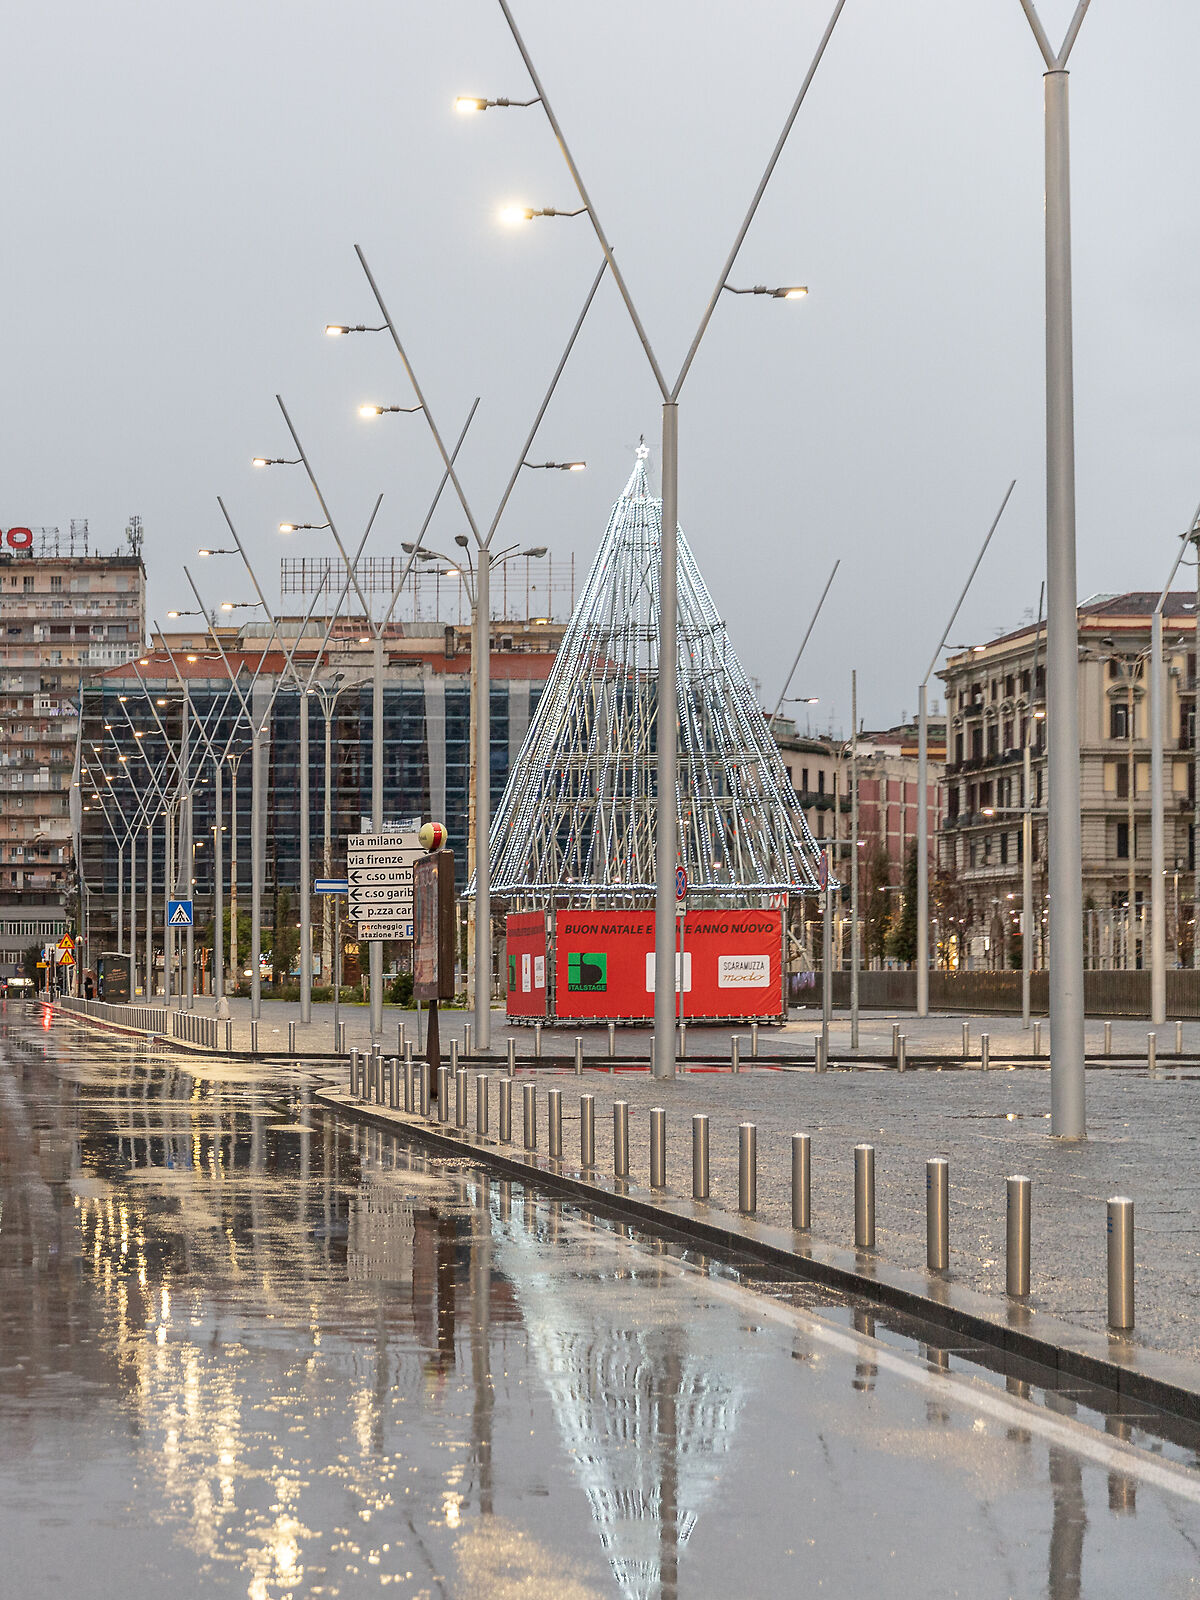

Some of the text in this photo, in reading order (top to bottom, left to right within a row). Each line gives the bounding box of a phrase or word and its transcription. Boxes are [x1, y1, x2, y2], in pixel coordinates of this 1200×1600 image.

[349, 836, 403, 846] via milano
[348, 855, 403, 865] via firenze
[366, 872, 386, 881] c.so
[364, 889, 386, 899] c.so
[367, 907, 394, 916] p.zza
[565, 925, 598, 934] BUON
[600, 925, 644, 934] NATALE
[646, 925, 653, 934] E
[694, 924, 729, 934] ANNO
[731, 923, 774, 934] NUOVO
[723, 961, 765, 971] SCARAMUZZA
